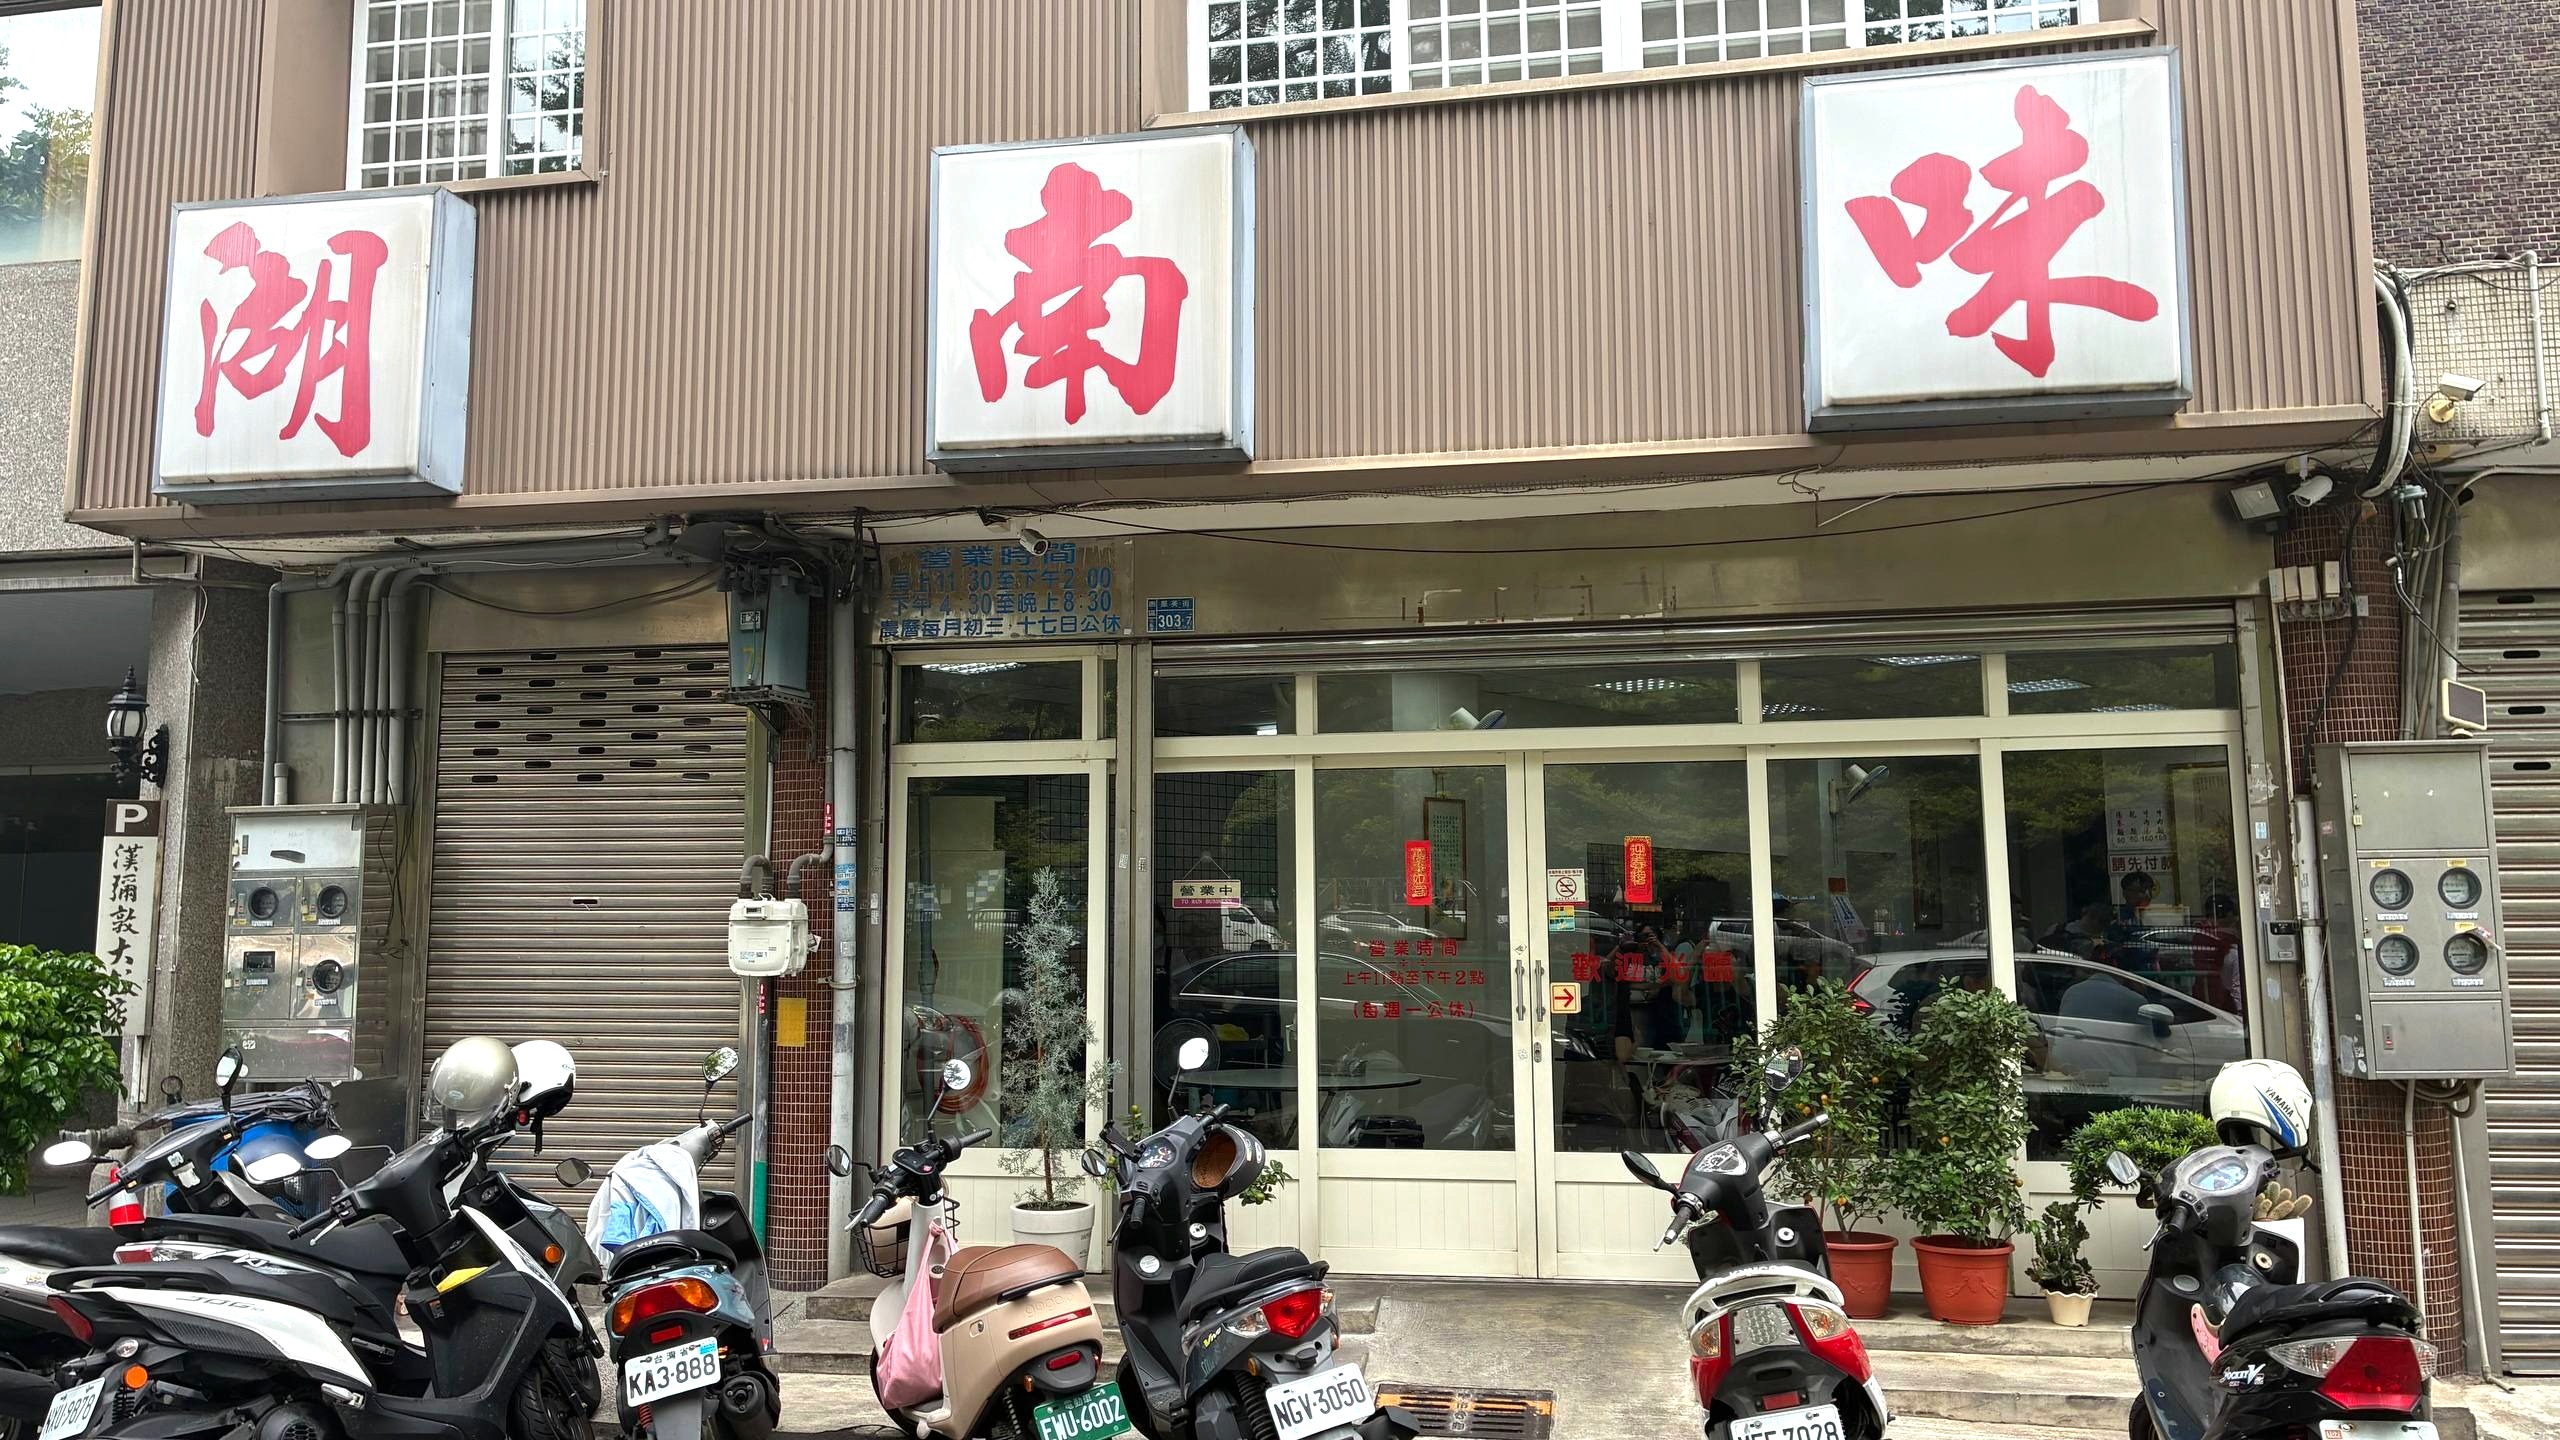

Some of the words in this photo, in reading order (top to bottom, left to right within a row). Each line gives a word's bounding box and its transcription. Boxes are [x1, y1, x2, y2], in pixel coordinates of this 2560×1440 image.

[1845, 85, 2158, 378] 味
[970, 162, 1188, 425] 南
[194, 221, 388, 457] 湖
[115, 803, 148, 833] P
[1180, 885, 1233, 897] 營業中
[1369, 939, 1457, 957] 營業時間
[1571, 951, 1734, 983] 歡迎光臨
[2265, 1086, 2294, 1118] YAMAHA
[629, 1353, 716, 1399] KA3-888
[1273, 1378, 1366, 1430] NGV-3050
